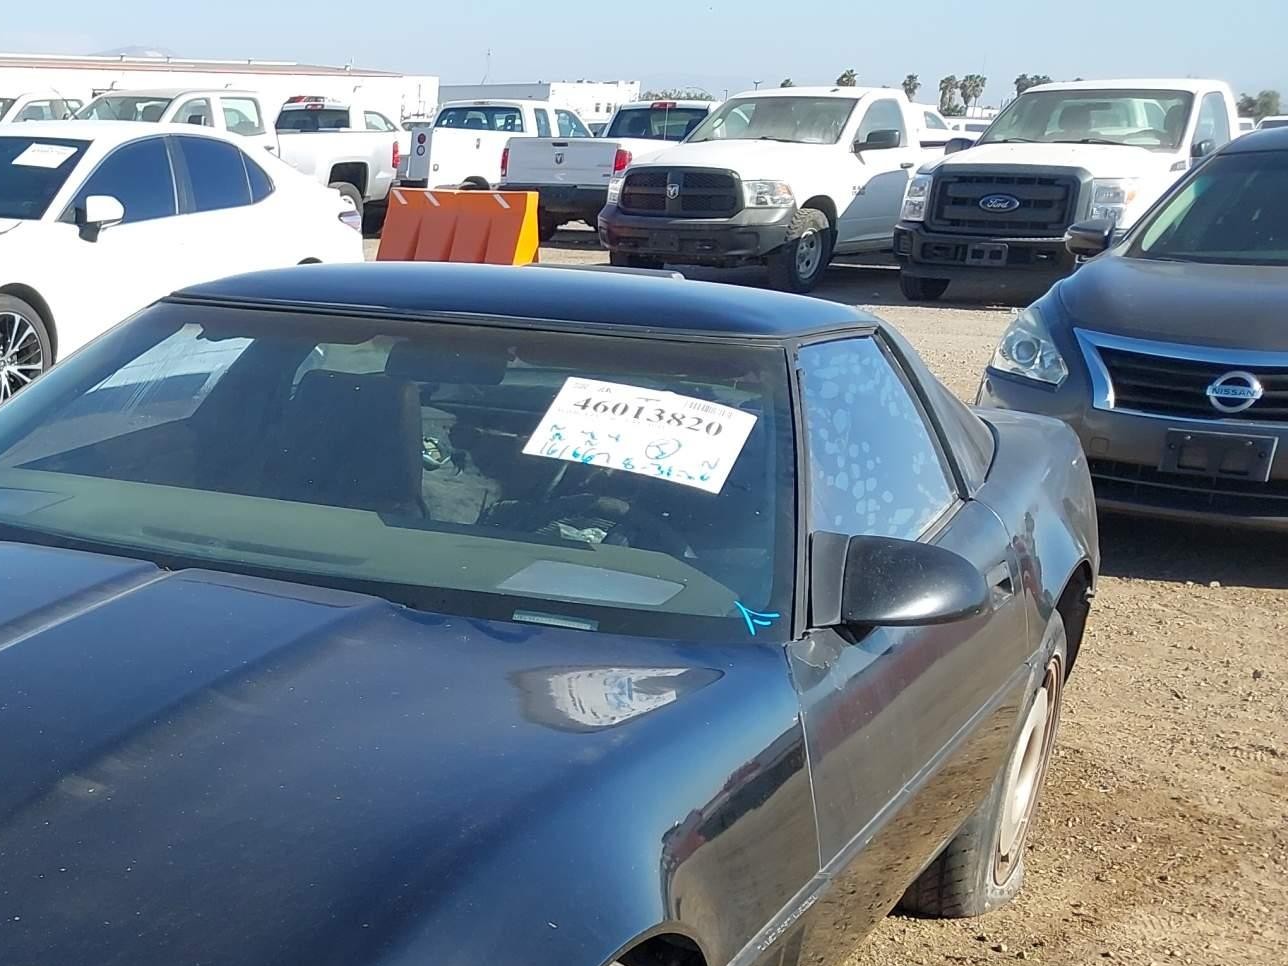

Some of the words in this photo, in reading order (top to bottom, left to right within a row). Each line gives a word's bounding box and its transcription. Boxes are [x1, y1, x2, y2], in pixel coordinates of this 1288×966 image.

[986, 198, 1010, 209] Ford
[1212, 387, 1256, 397] NISSAN
[573, 397, 723, 437] 46013820
